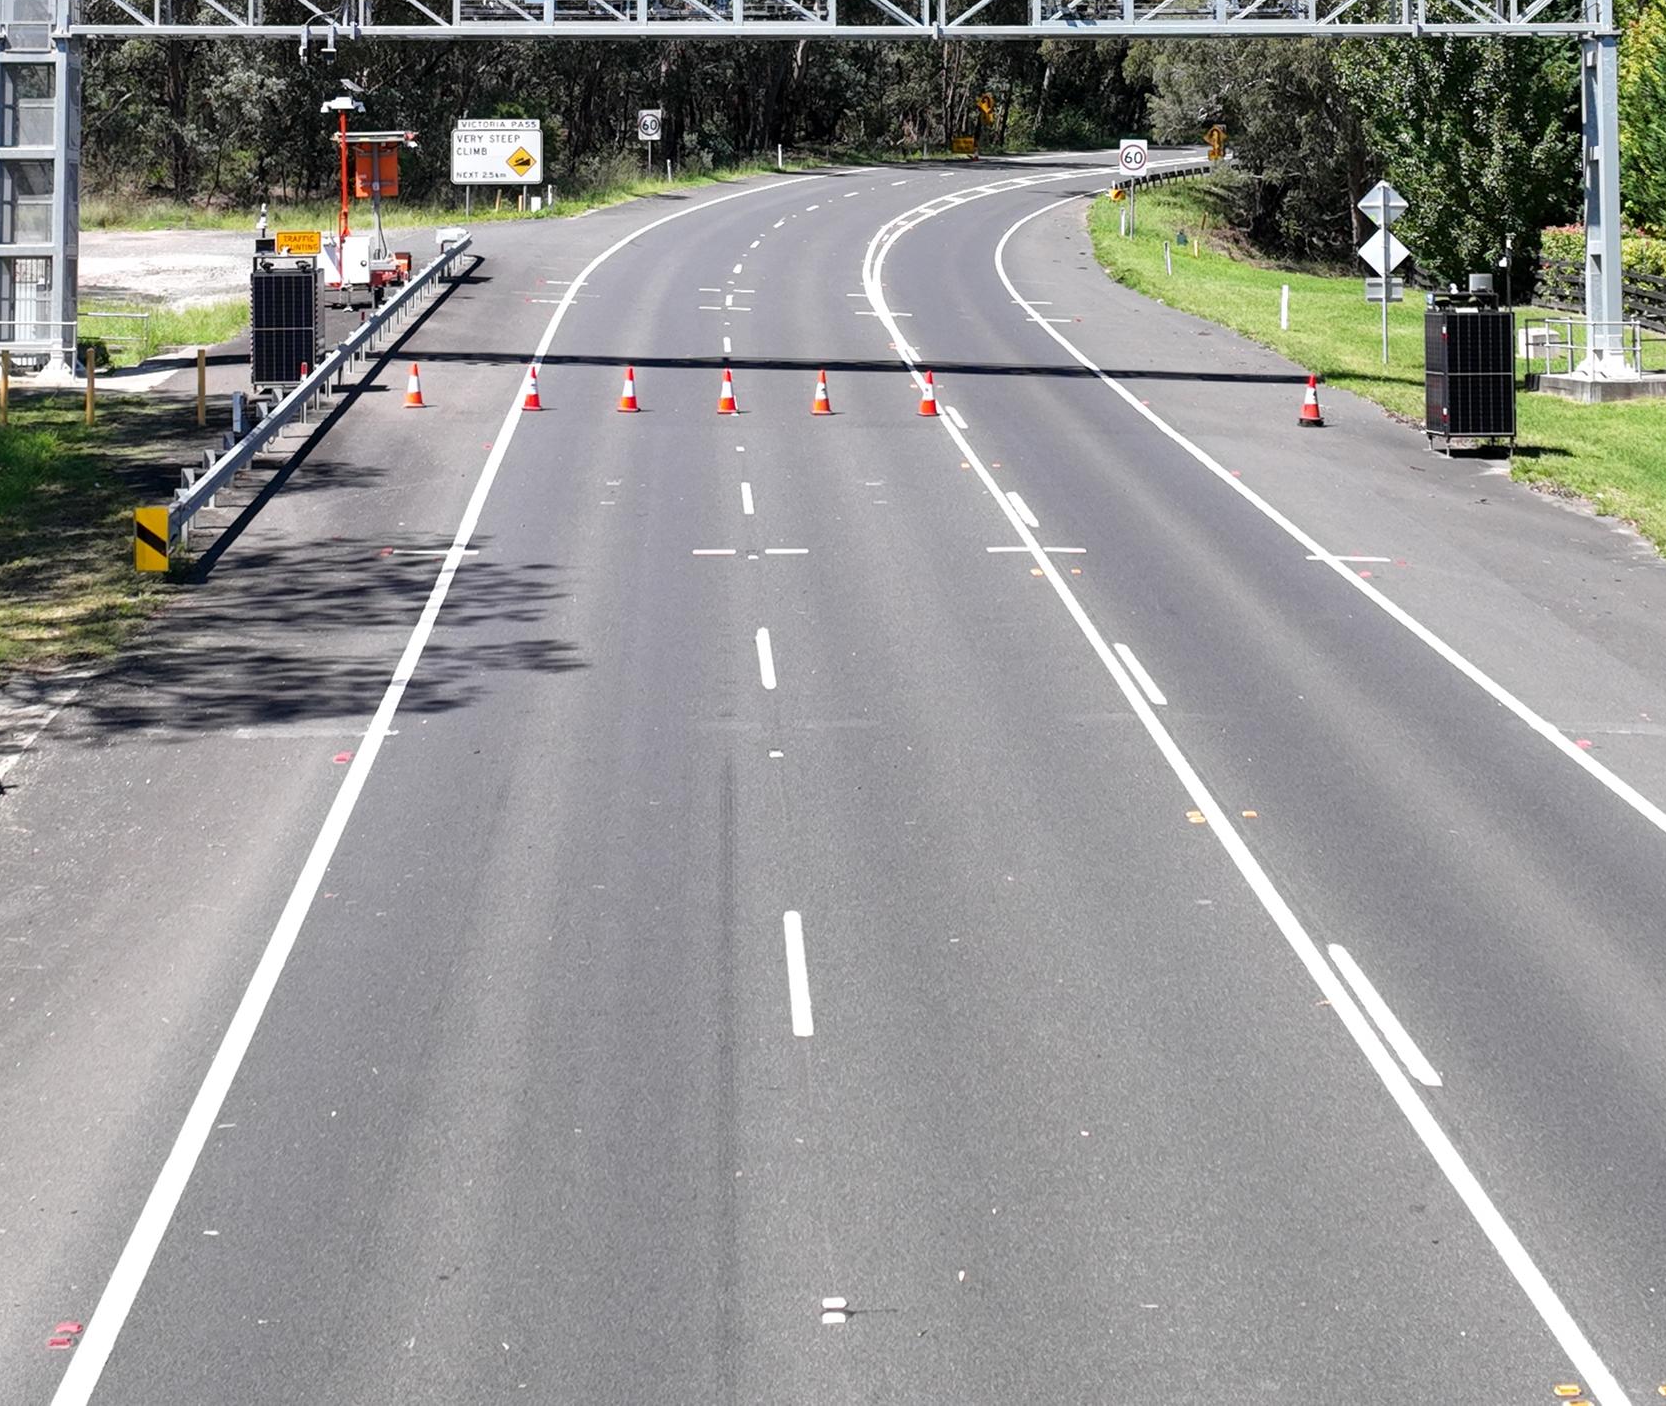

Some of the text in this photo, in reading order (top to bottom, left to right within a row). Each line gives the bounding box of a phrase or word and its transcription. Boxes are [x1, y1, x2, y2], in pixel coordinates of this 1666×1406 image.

[643, 119, 658, 131] 60
[457, 135, 520, 143] VERY STEEP
[456, 147, 488, 156] CLIMB
[1124, 151, 1143, 164] 60
[284, 235, 315, 243] TRAFFIC
